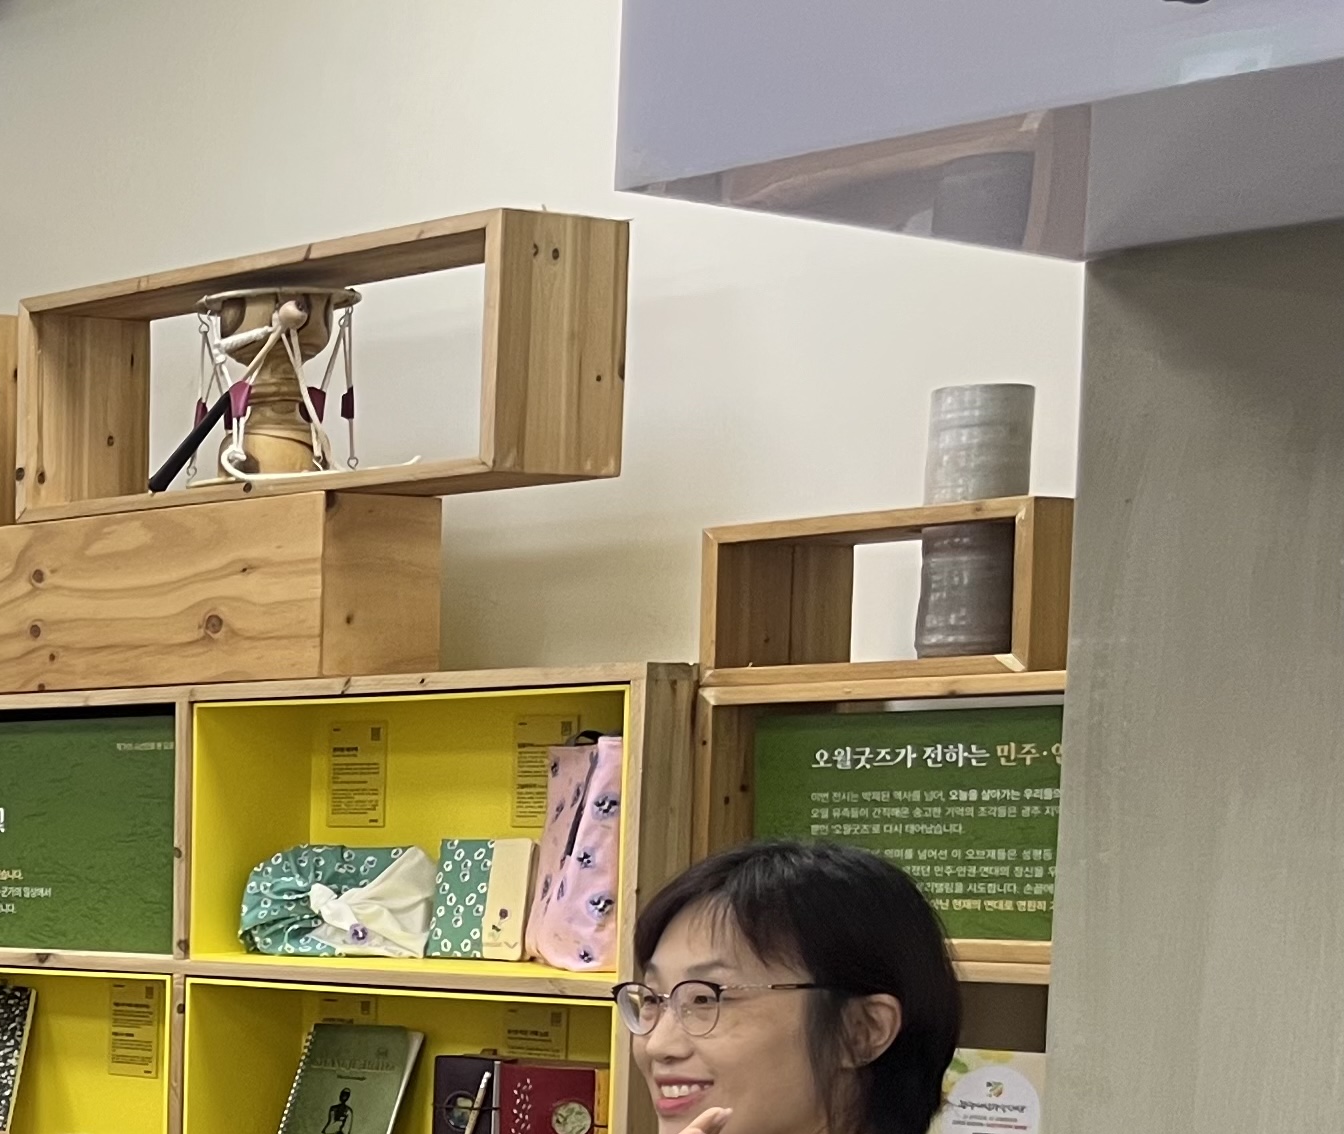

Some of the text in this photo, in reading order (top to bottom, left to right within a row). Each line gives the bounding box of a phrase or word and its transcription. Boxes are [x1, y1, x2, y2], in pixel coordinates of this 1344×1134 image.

[811, 744, 917, 770] 오월굿즈가
[922, 743, 990, 768] 전하는
[948, 789, 978, 802] 오늘을
[981, 789, 1021, 802] 살아가는
[945, 806, 975, 818] 기억의
[977, 805, 1017, 818] 조각들은
[883, 823, 903, 834] 다시
[951, 849, 961, 860] 이
